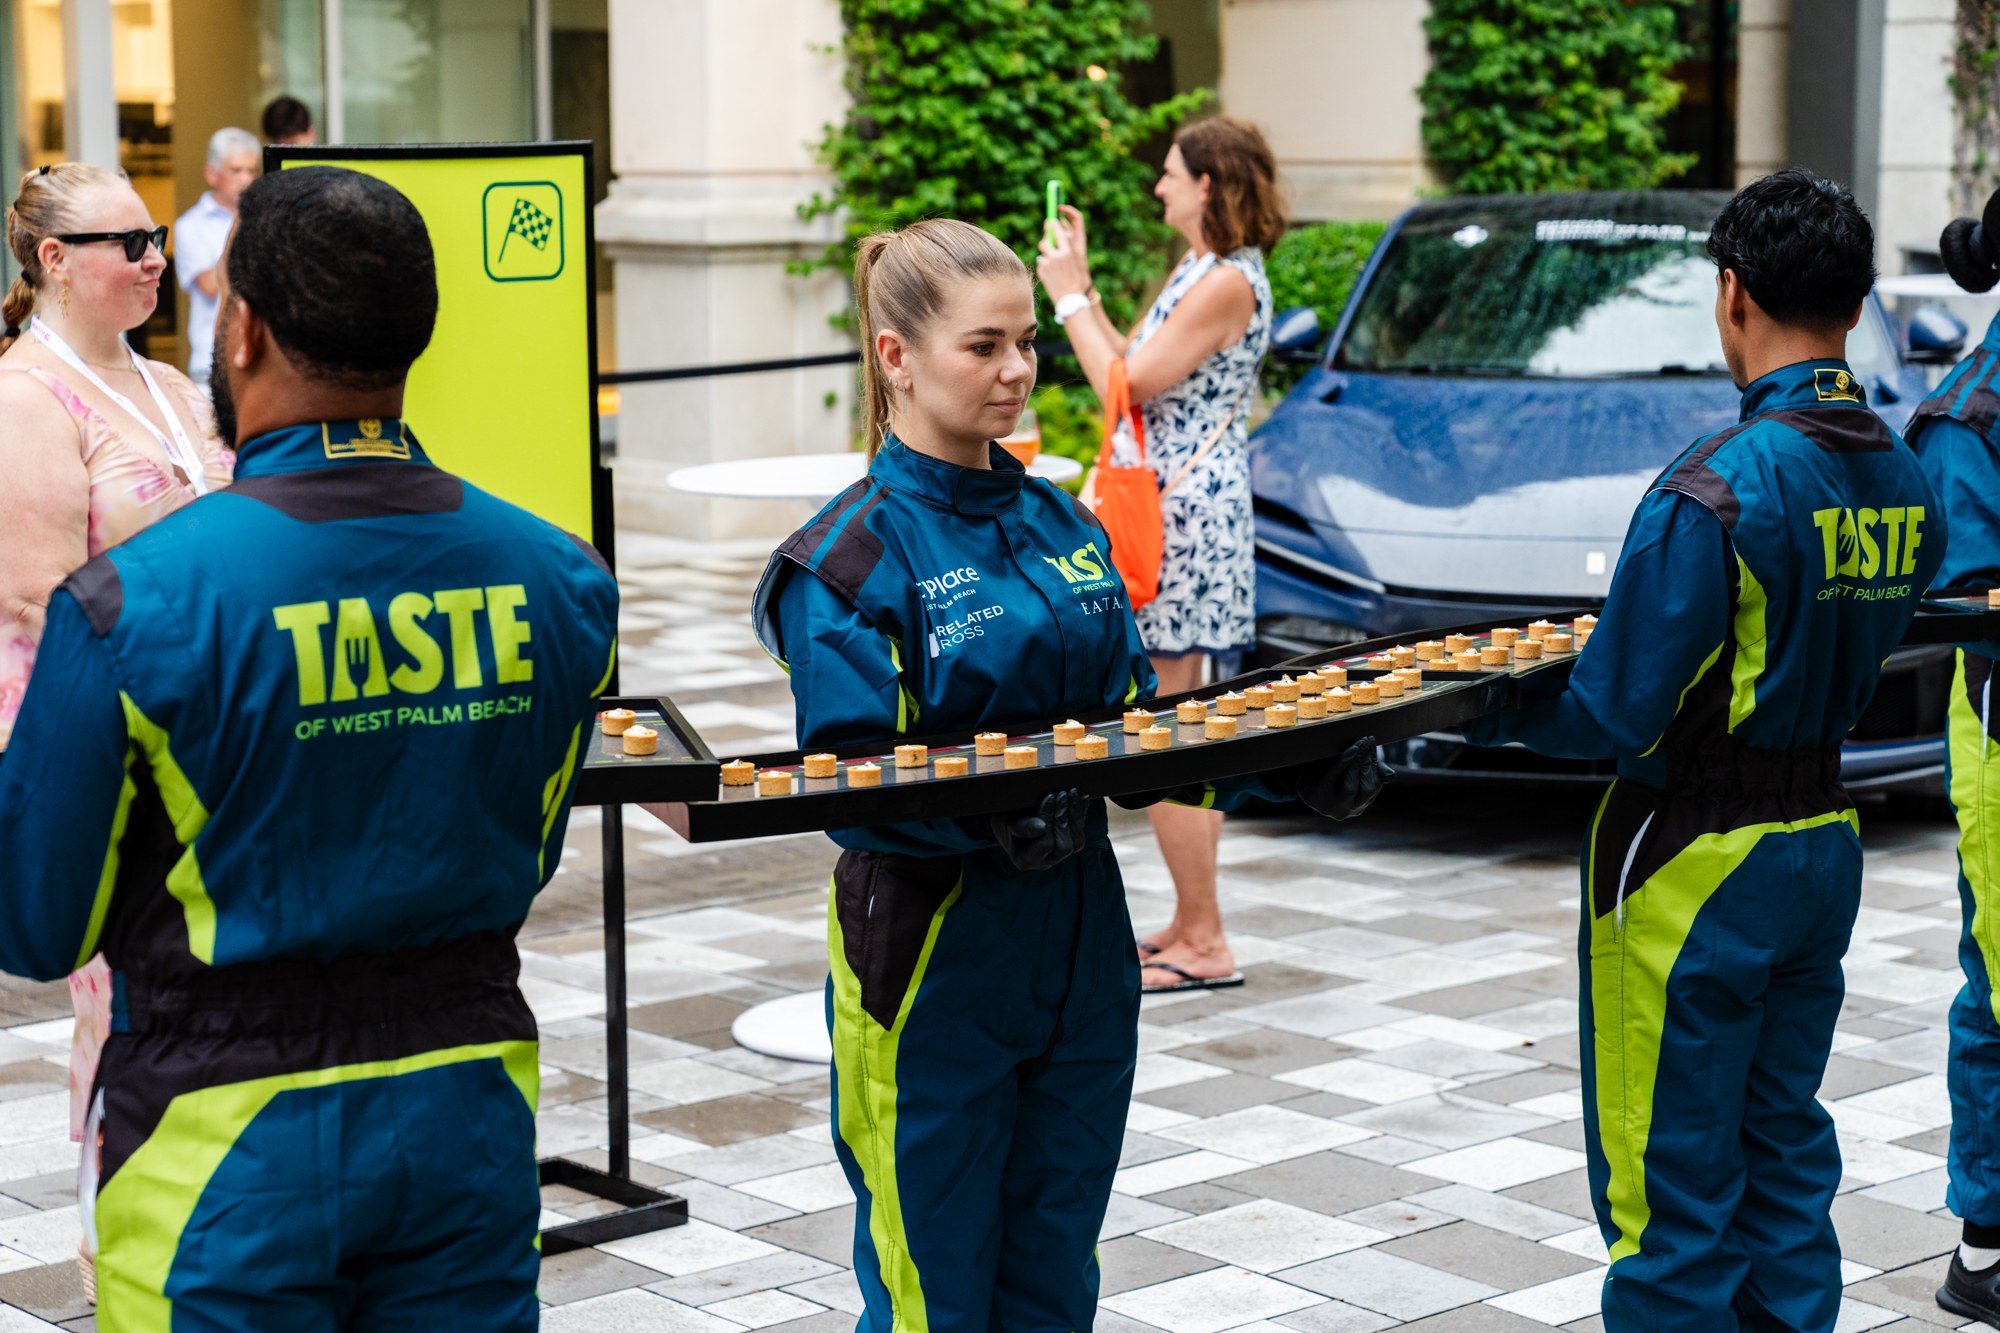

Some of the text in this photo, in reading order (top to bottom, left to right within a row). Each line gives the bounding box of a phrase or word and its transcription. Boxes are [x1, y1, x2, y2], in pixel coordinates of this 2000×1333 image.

[1813, 506, 1925, 580] TASTE
[953, 589, 976, 601] BEACH
[1072, 586, 1083, 595] OF
[1083, 582, 1101, 592] WEST
[1817, 588, 1835, 601] OF
[1854, 588, 1885, 601] PALM
[1081, 596, 1123, 615] EATA
[936, 605, 1004, 636] RELATED
[272, 584, 534, 706] TASTE
[940, 625, 985, 649] ROSS
[295, 696, 532, 740] OF WEST PALM BEACH
